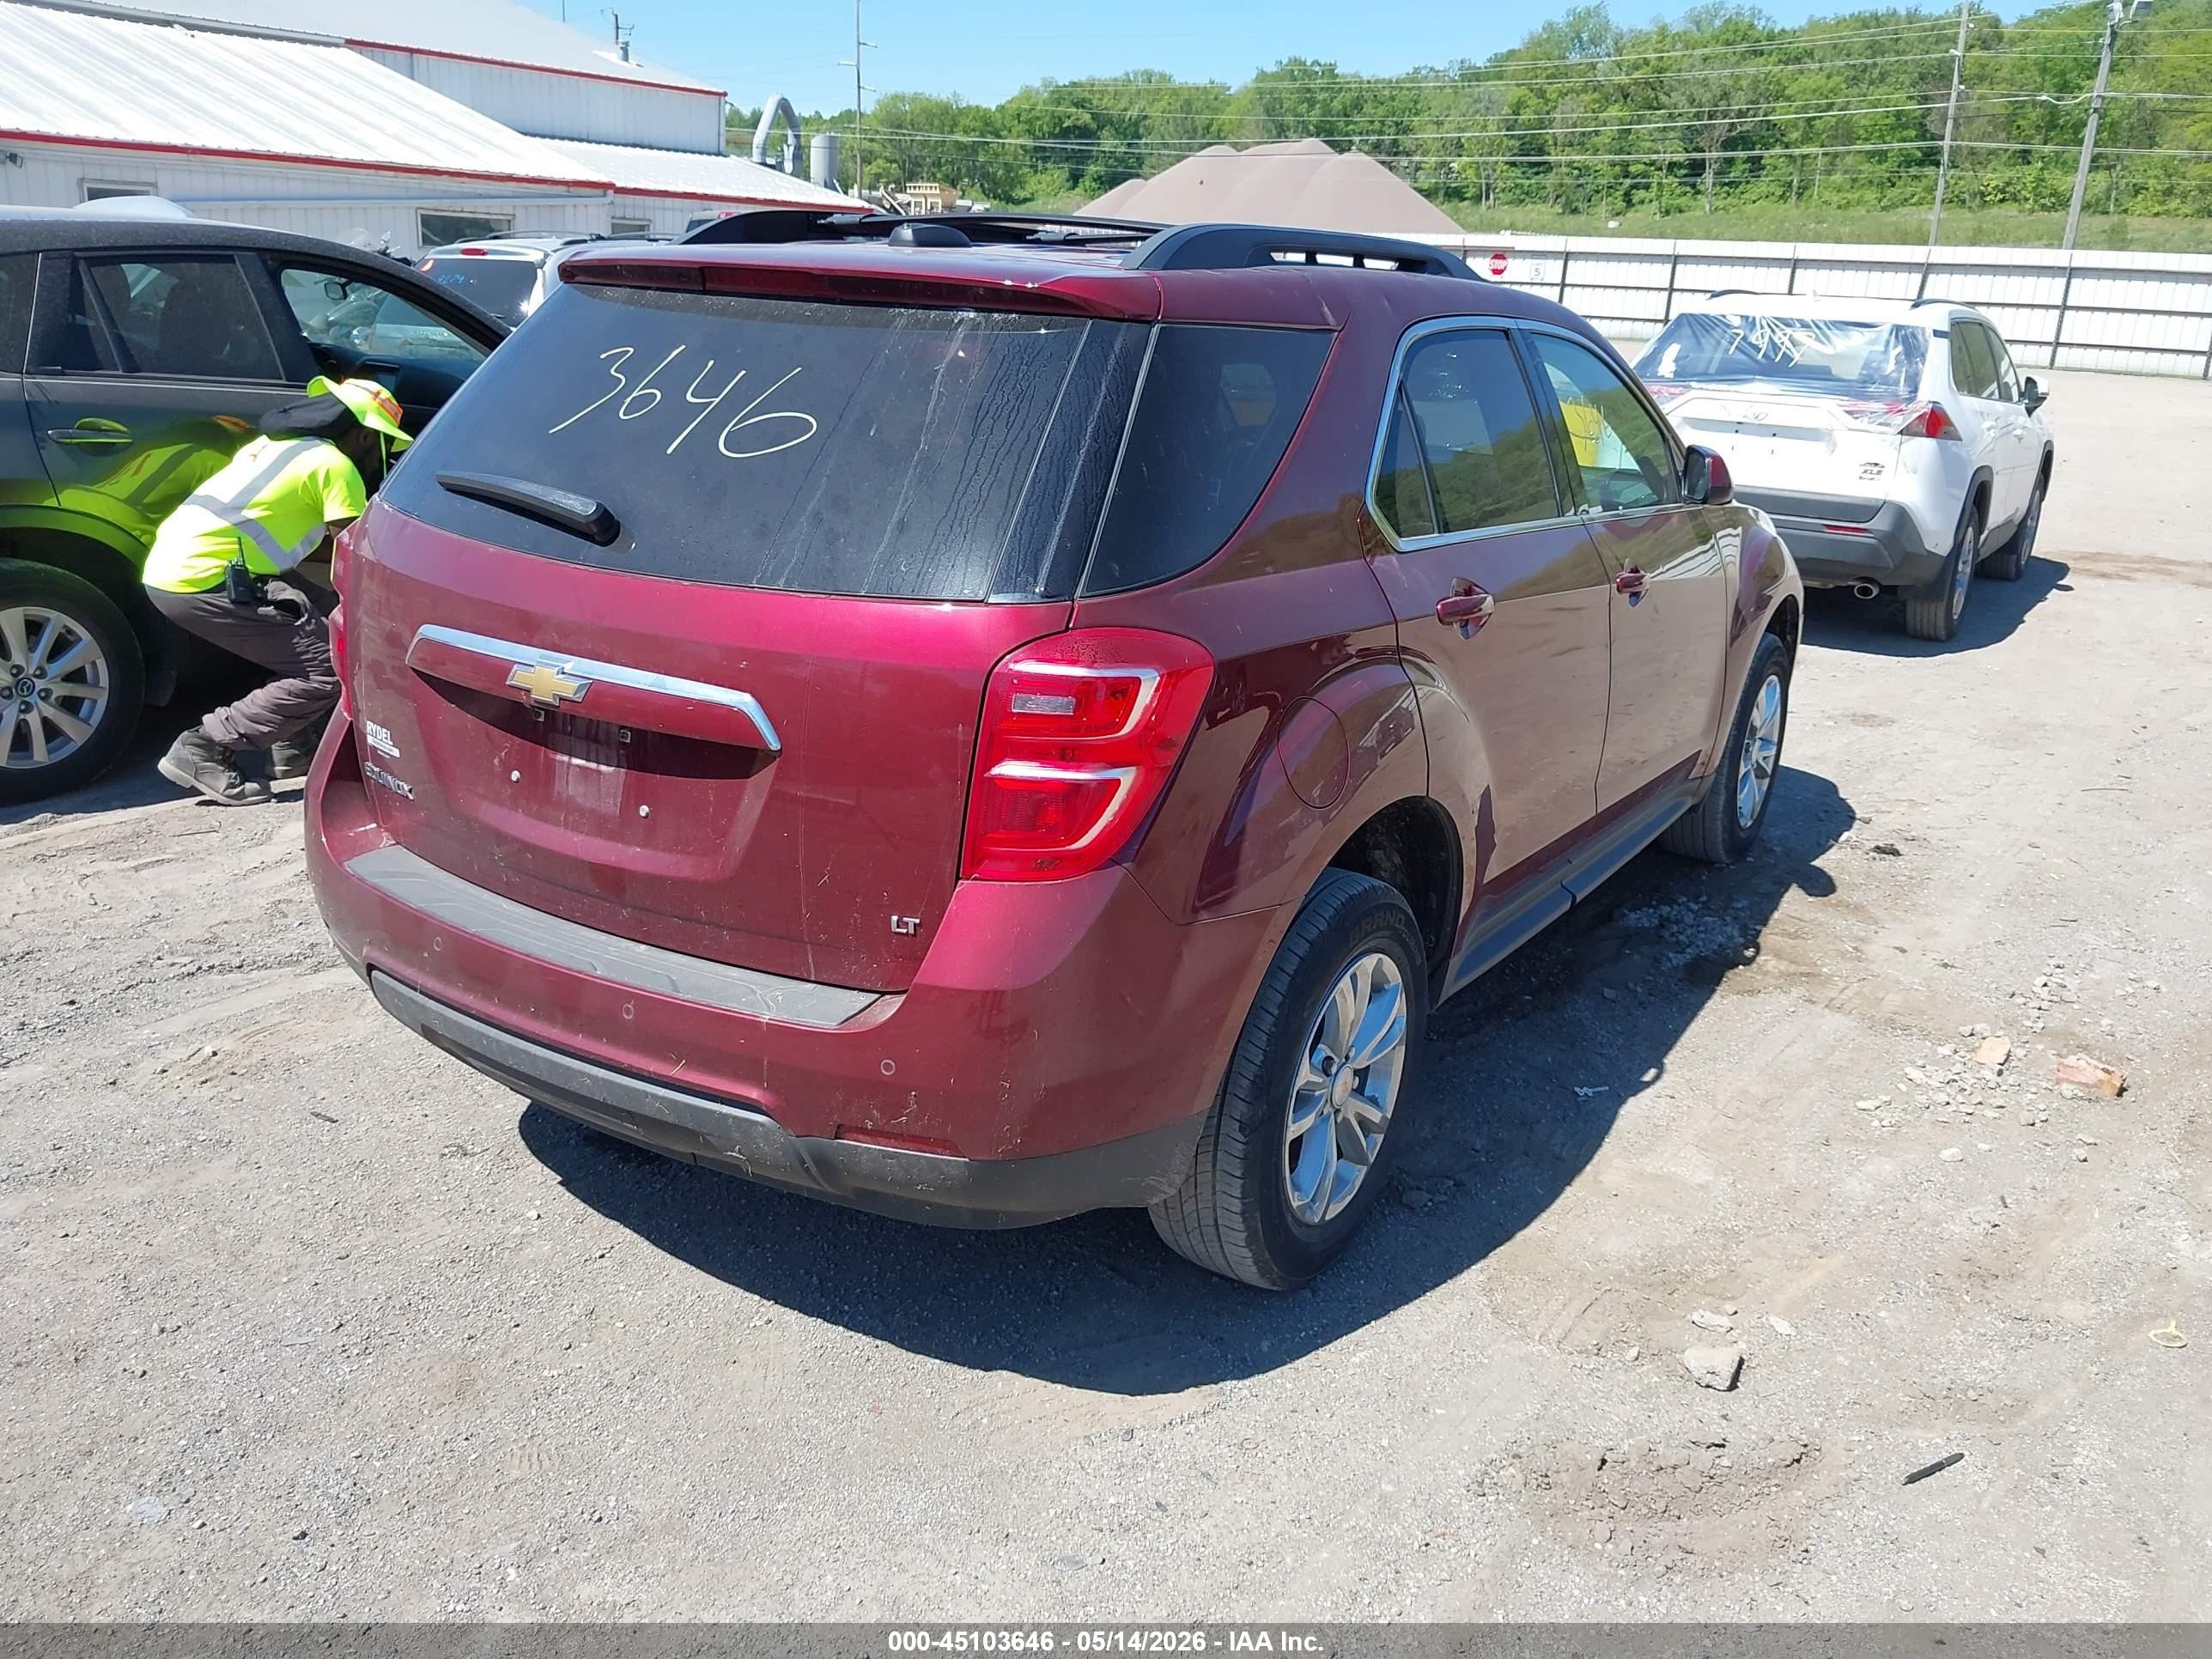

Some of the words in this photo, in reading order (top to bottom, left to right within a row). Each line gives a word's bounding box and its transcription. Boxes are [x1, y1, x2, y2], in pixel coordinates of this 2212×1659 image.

[1489, 258, 1508, 270] STOP
[1534, 267, 1540, 276] 5
[548, 344, 817, 458] 3646
[367, 720, 393, 745] RYDEL
[364, 761, 414, 800] EQUINOX
[890, 915, 921, 934] LT
